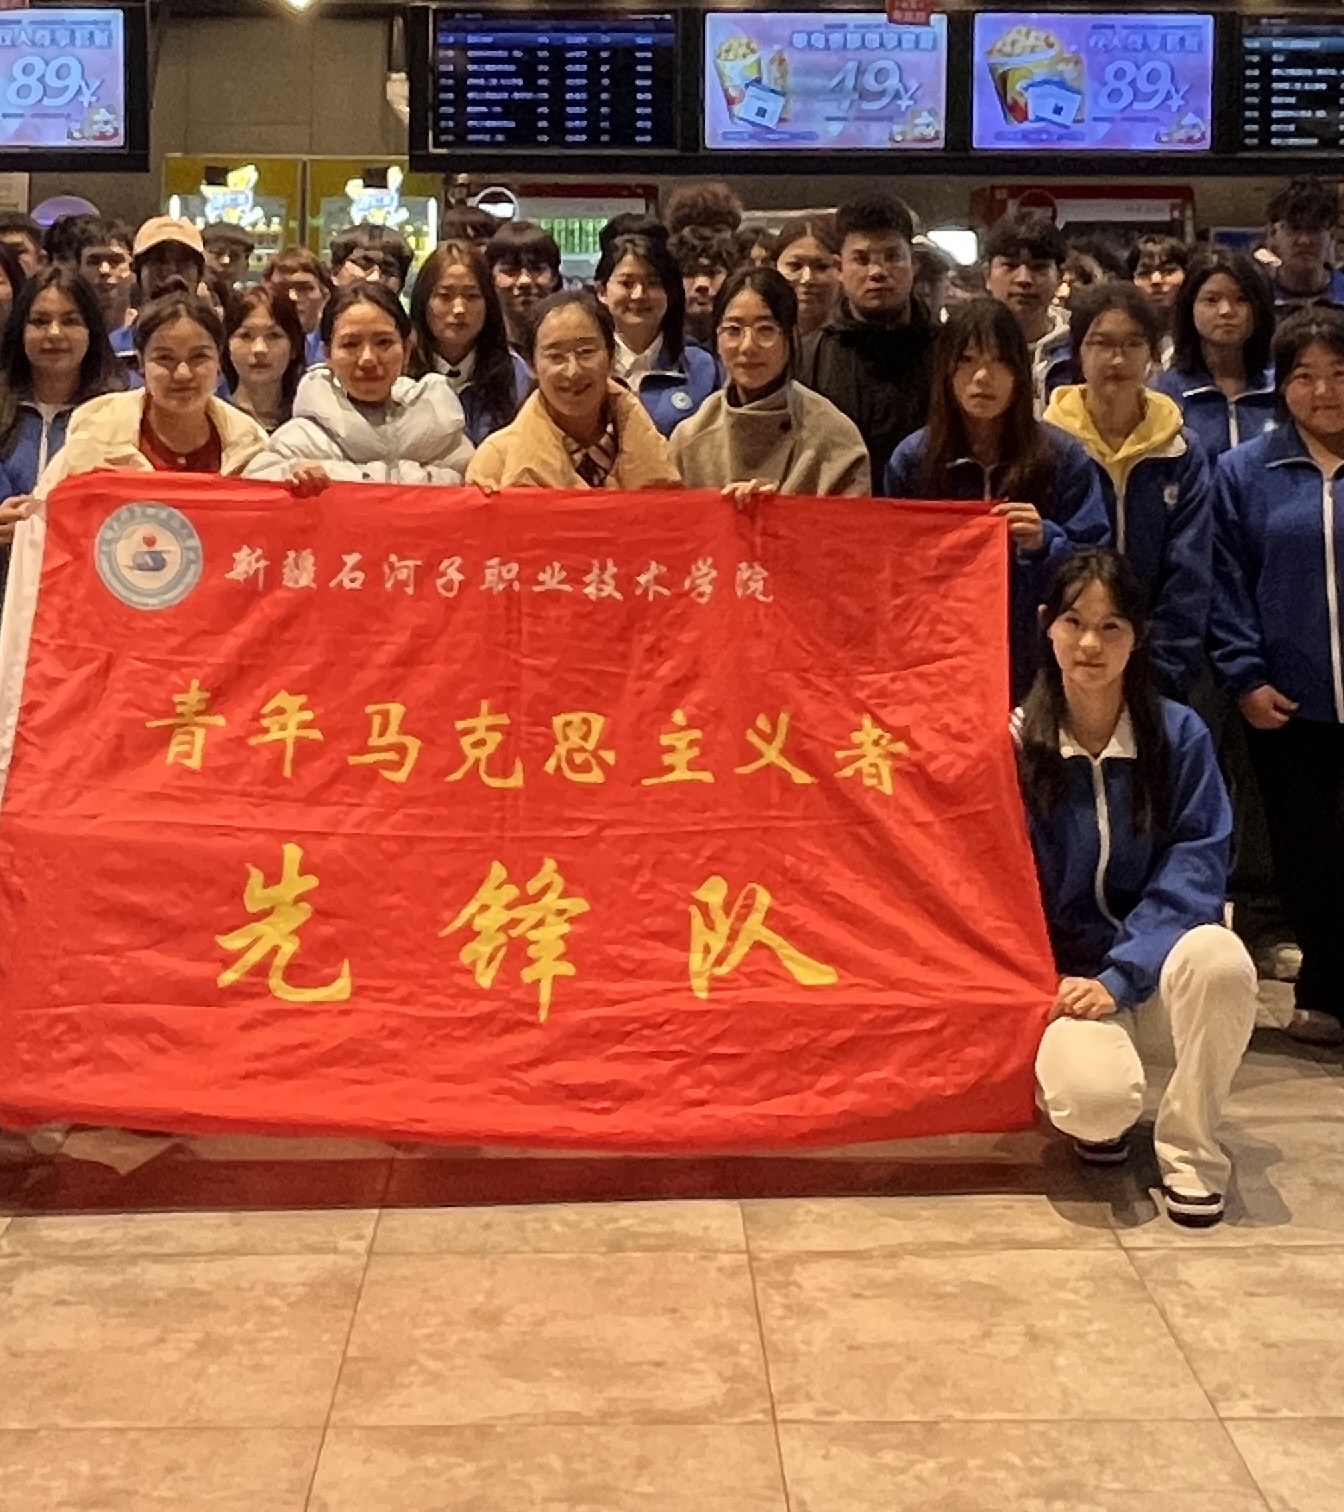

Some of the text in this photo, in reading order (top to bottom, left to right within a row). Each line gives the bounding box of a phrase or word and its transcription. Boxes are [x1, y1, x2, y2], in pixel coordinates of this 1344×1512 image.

[224, 542, 775, 605] 新疆石河子职业技术学院
[144, 678, 911, 796] 青年马克思主义者
[214, 842, 839, 1023] 先锋队
